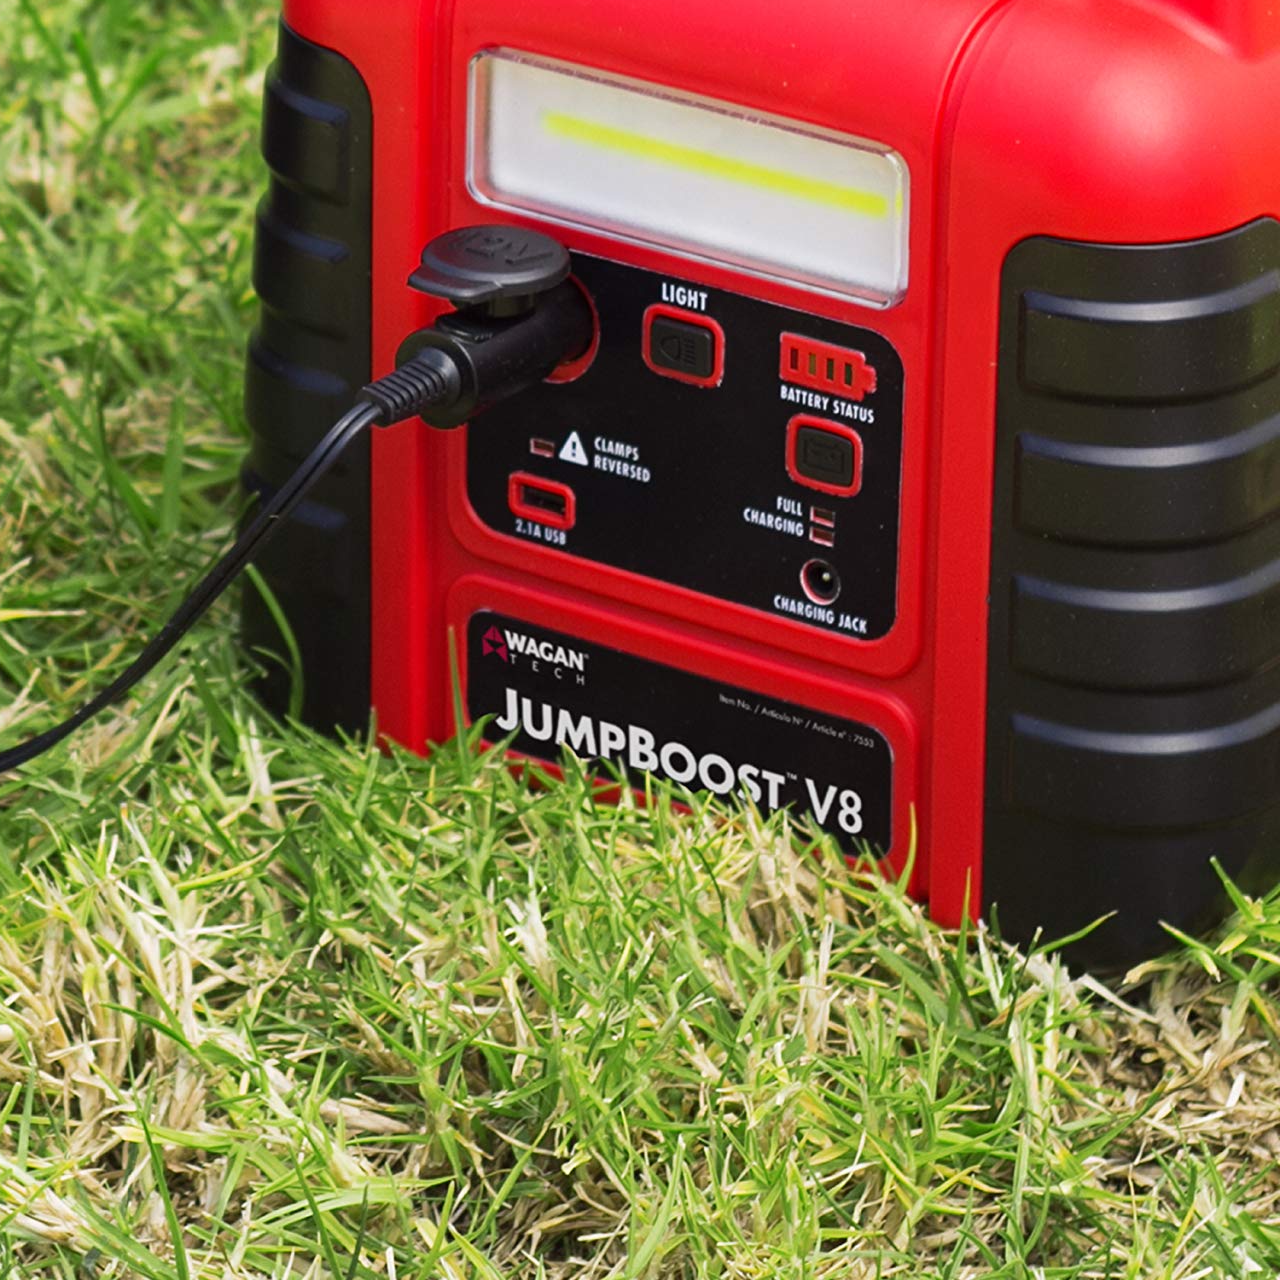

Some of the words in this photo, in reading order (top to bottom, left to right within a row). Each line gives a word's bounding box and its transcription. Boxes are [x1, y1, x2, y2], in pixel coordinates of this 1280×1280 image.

[661, 282, 708, 311] LIGHT
[780, 385, 828, 411] BATTERY
[833, 399, 875, 424] STATUS
[593, 436, 639, 461] CLAMPS
[593, 455, 651, 483] REVERSED
[776, 496, 803, 517] FULL
[514, 518, 542, 538] 2.1A
[544, 526, 567, 545] USB
[743, 508, 804, 537] CHARGING
[773, 594, 835, 625] CHARGING
[838, 614, 868, 634] JACK
[504, 629, 585, 671] WAGAN
[804, 777, 863, 834] V8
